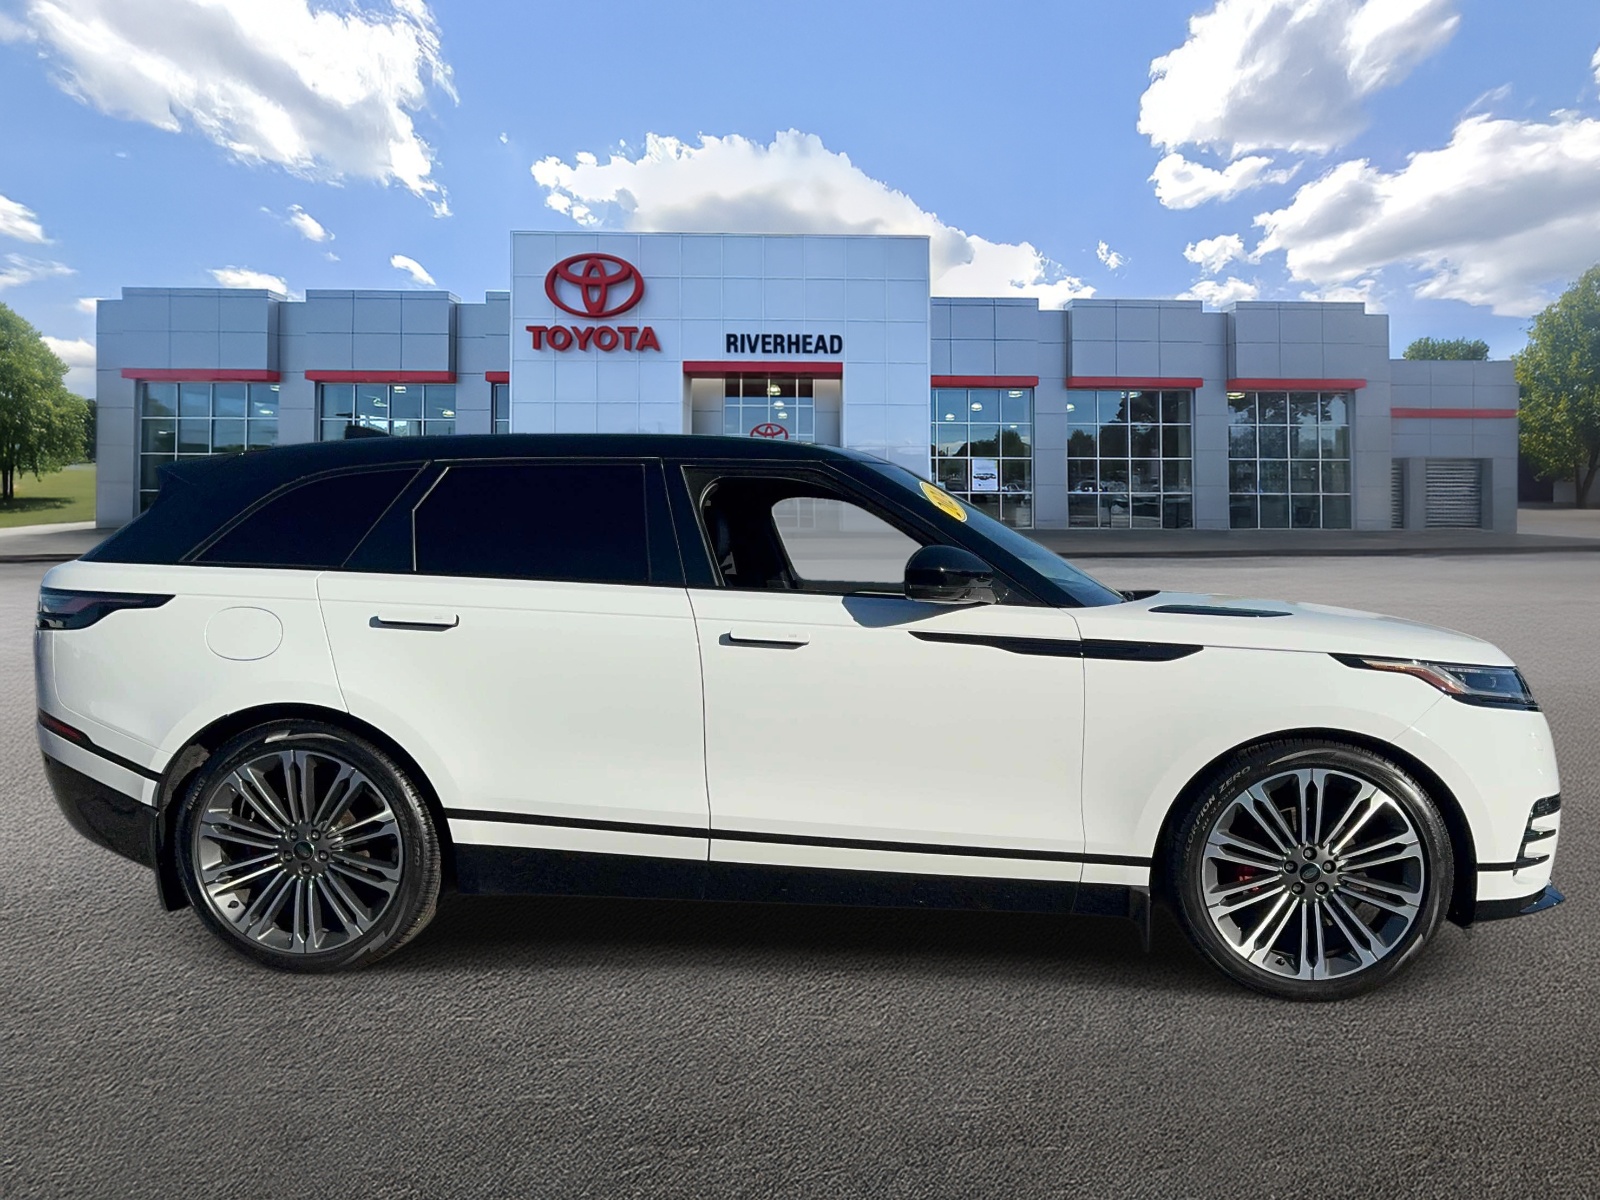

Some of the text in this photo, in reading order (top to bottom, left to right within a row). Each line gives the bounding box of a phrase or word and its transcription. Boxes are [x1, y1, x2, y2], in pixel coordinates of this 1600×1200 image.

[525, 325, 661, 351] TOYOTA
[725, 333, 844, 354] RIVERHEAD
[1183, 794, 1216, 861] SCORPION
[1219, 765, 1251, 794] ZERO
